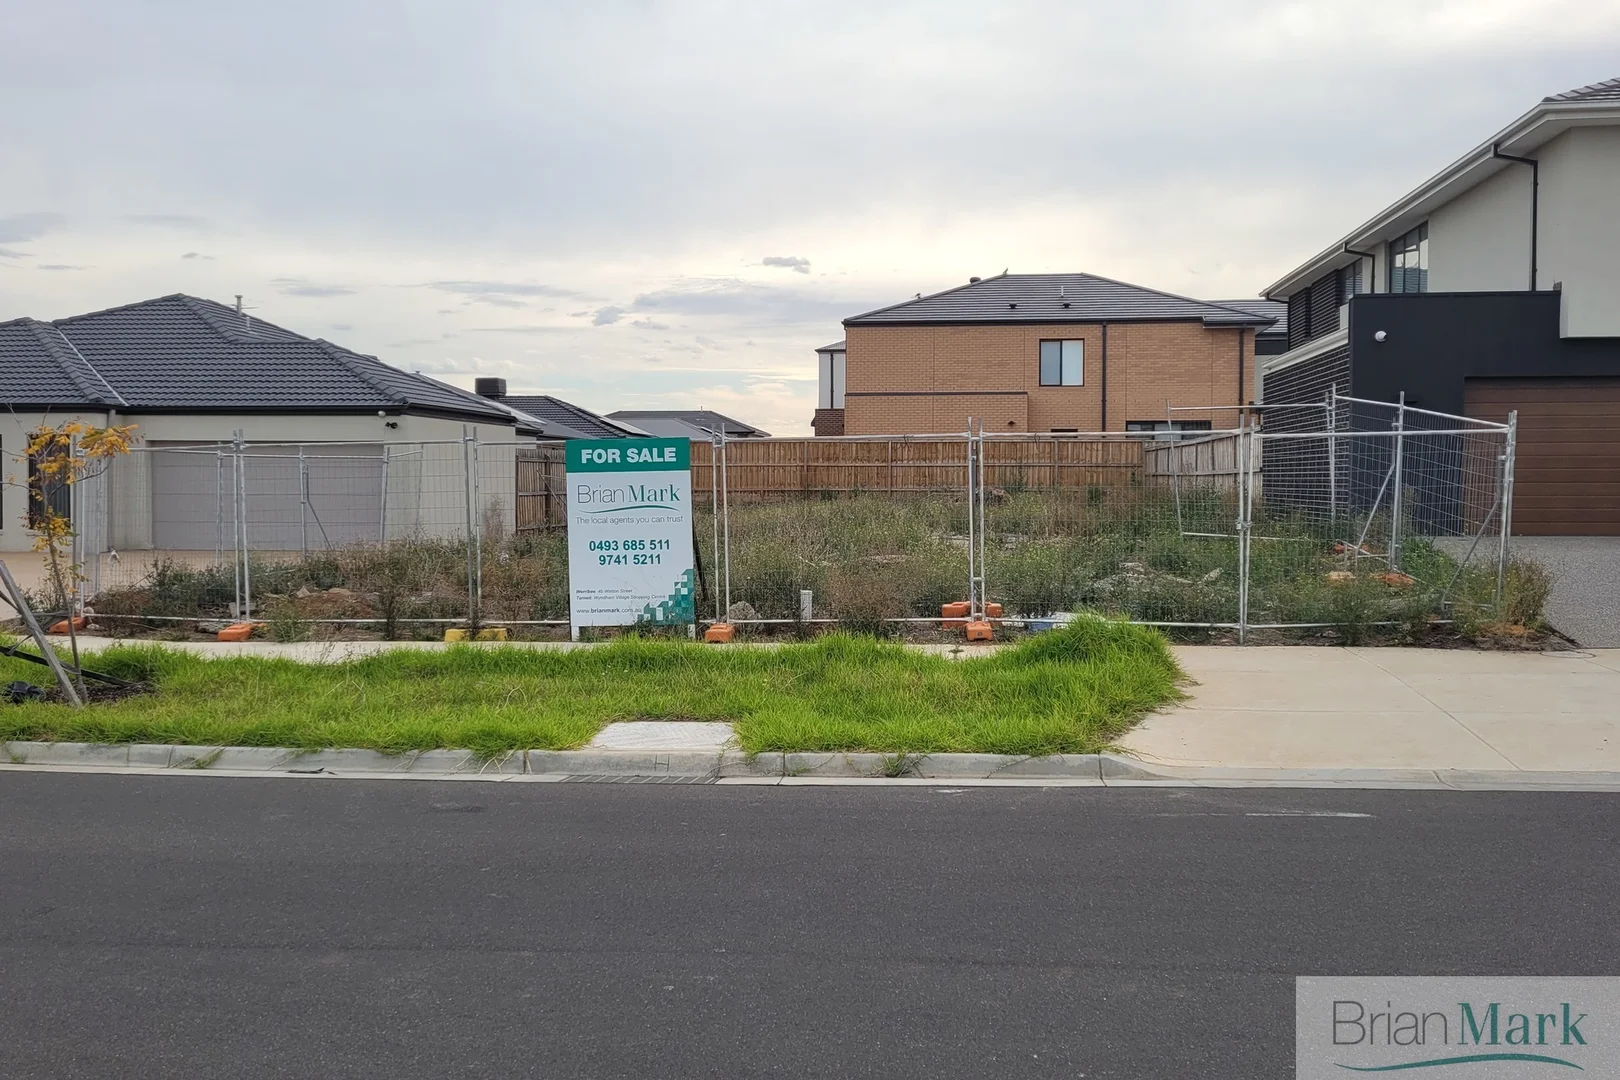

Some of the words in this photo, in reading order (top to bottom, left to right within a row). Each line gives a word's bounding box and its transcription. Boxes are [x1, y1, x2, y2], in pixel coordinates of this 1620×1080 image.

[581, 448, 620, 464] FOR
[626, 447, 677, 463] SALE
[577, 485, 624, 503] Brian
[628, 484, 681, 502] Mark
[576, 517, 589, 525] The
[591, 516, 608, 525] local
[610, 516, 635, 526] agents
[635, 516, 651, 525] you
[667, 515, 684, 523] trust
[589, 540, 619, 551] 0493
[623, 540, 646, 551] 685
[649, 539, 670, 550] 511
[599, 555, 628, 565] 9741
[633, 554, 661, 565] 5211
